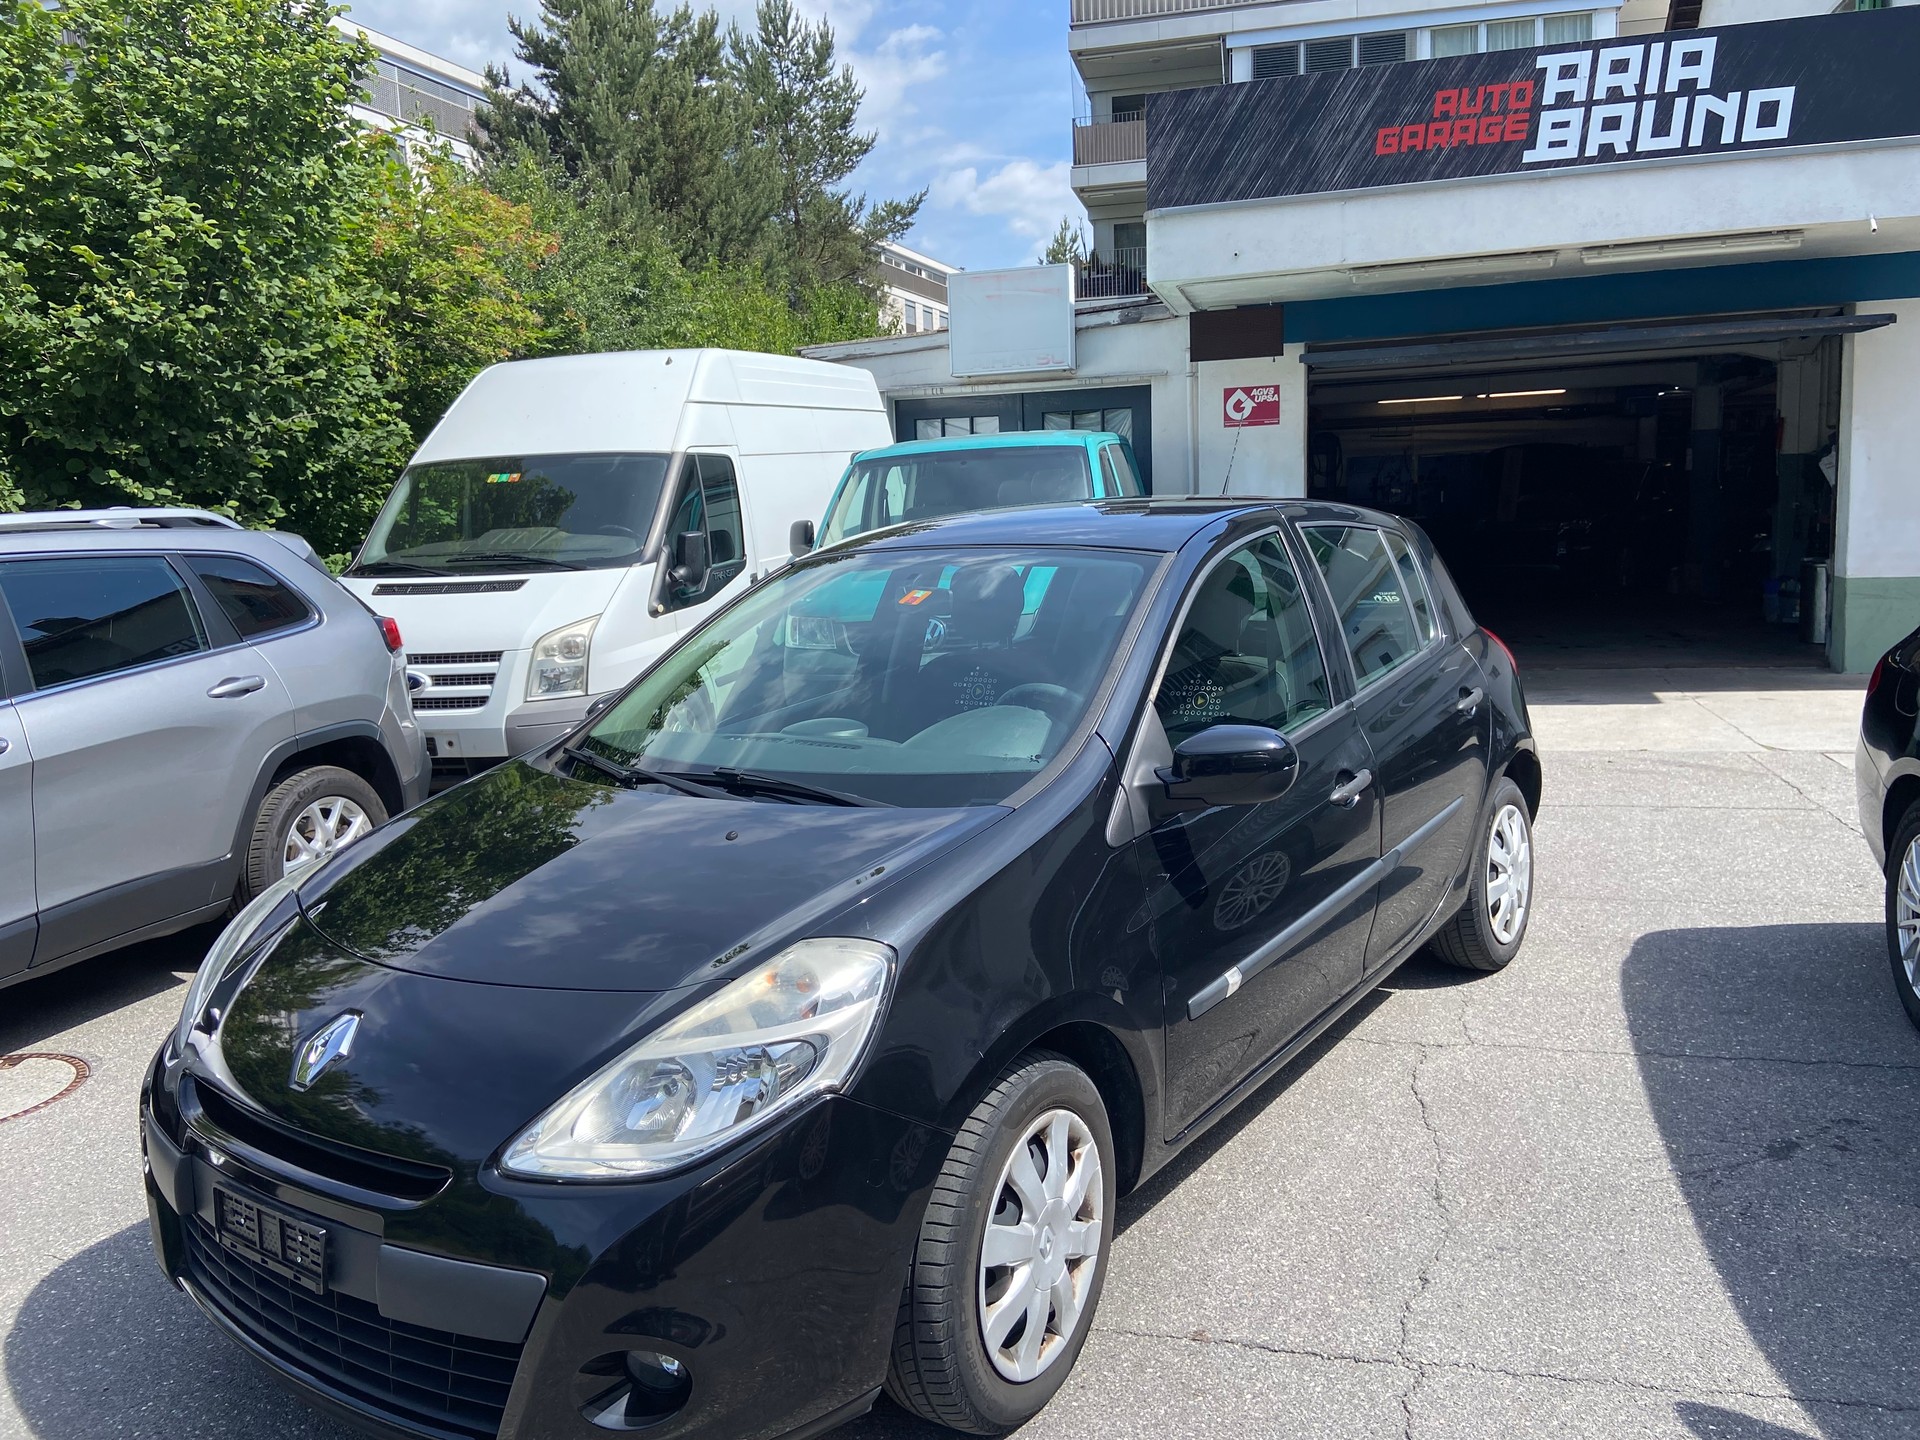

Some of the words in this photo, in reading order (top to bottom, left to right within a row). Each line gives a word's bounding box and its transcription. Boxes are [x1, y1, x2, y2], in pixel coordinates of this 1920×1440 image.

[1536, 37, 1717, 106] ARIA
[1433, 80, 1534, 118] AUTO
[1375, 113, 1529, 155] GARAGE
[1522, 86, 1796, 163] BRUNO
[1250, 387, 1274, 396] AGVS
[1254, 394, 1278, 402] UPSA
